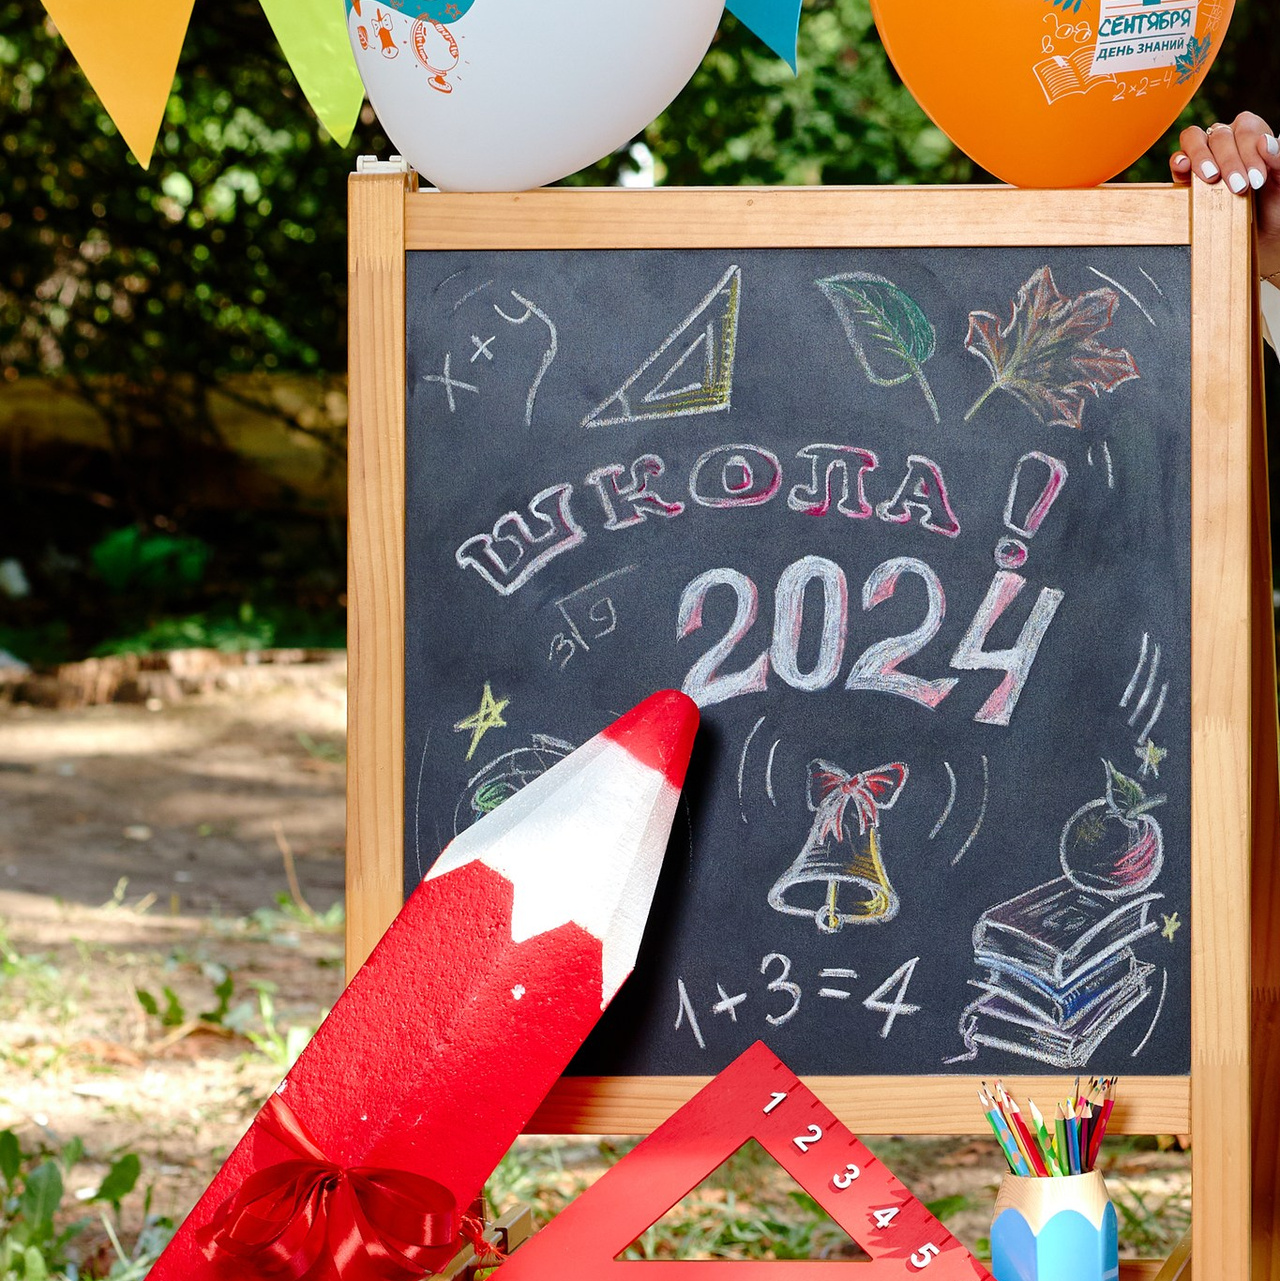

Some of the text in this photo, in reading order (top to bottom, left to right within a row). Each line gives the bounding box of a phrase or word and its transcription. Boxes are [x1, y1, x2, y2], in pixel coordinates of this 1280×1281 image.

[1096, 37, 1185, 62] ДЕНЬ ЗНАНИЙ
[1098, 8, 1192, 38] СЕНТЯБРЯ
[676, 554, 1065, 726] 2024
[762, 1091, 788, 1114] 1
[794, 1124, 823, 1153] 2
[832, 1163, 861, 1190] 3
[872, 1206, 900, 1230] 4
[911, 1242, 940, 1269] 5
